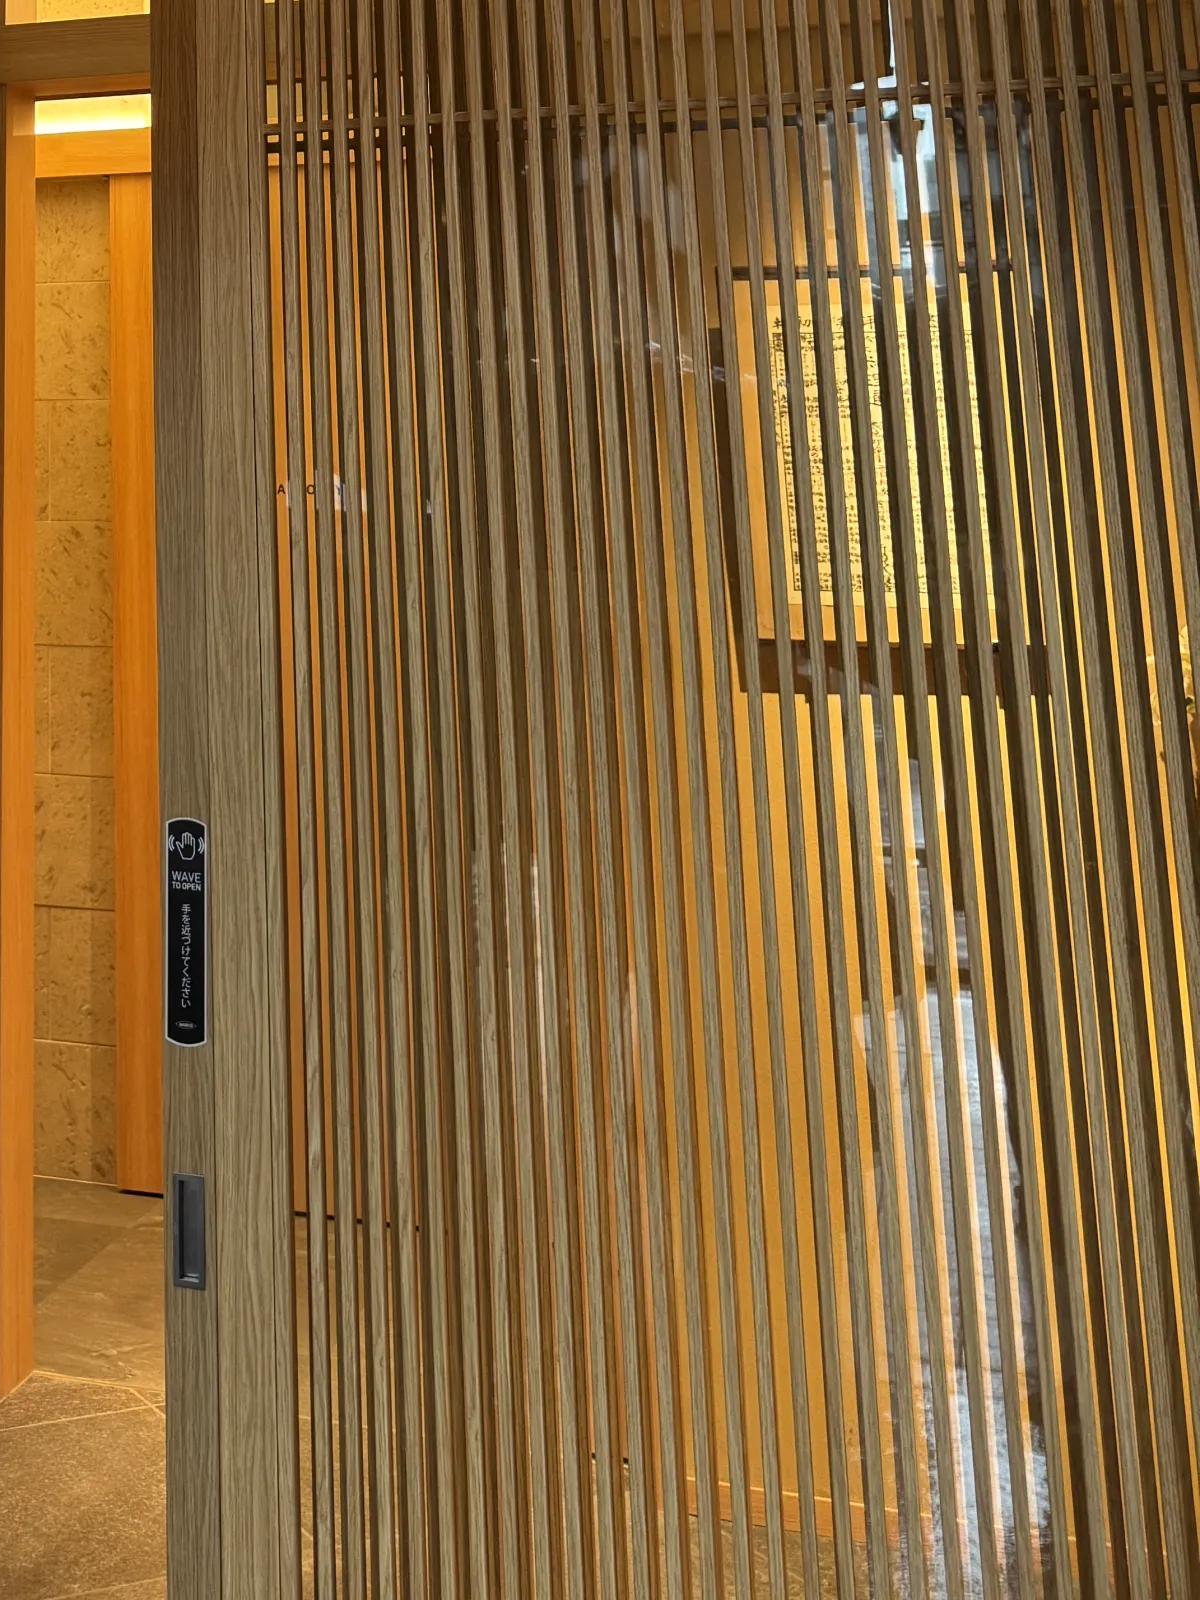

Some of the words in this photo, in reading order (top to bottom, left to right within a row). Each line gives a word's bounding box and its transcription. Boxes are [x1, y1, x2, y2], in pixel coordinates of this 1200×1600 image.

[171, 870, 202, 884] WAVE
[171, 881, 181, 890] TO
[182, 882, 202, 892] OPEN
